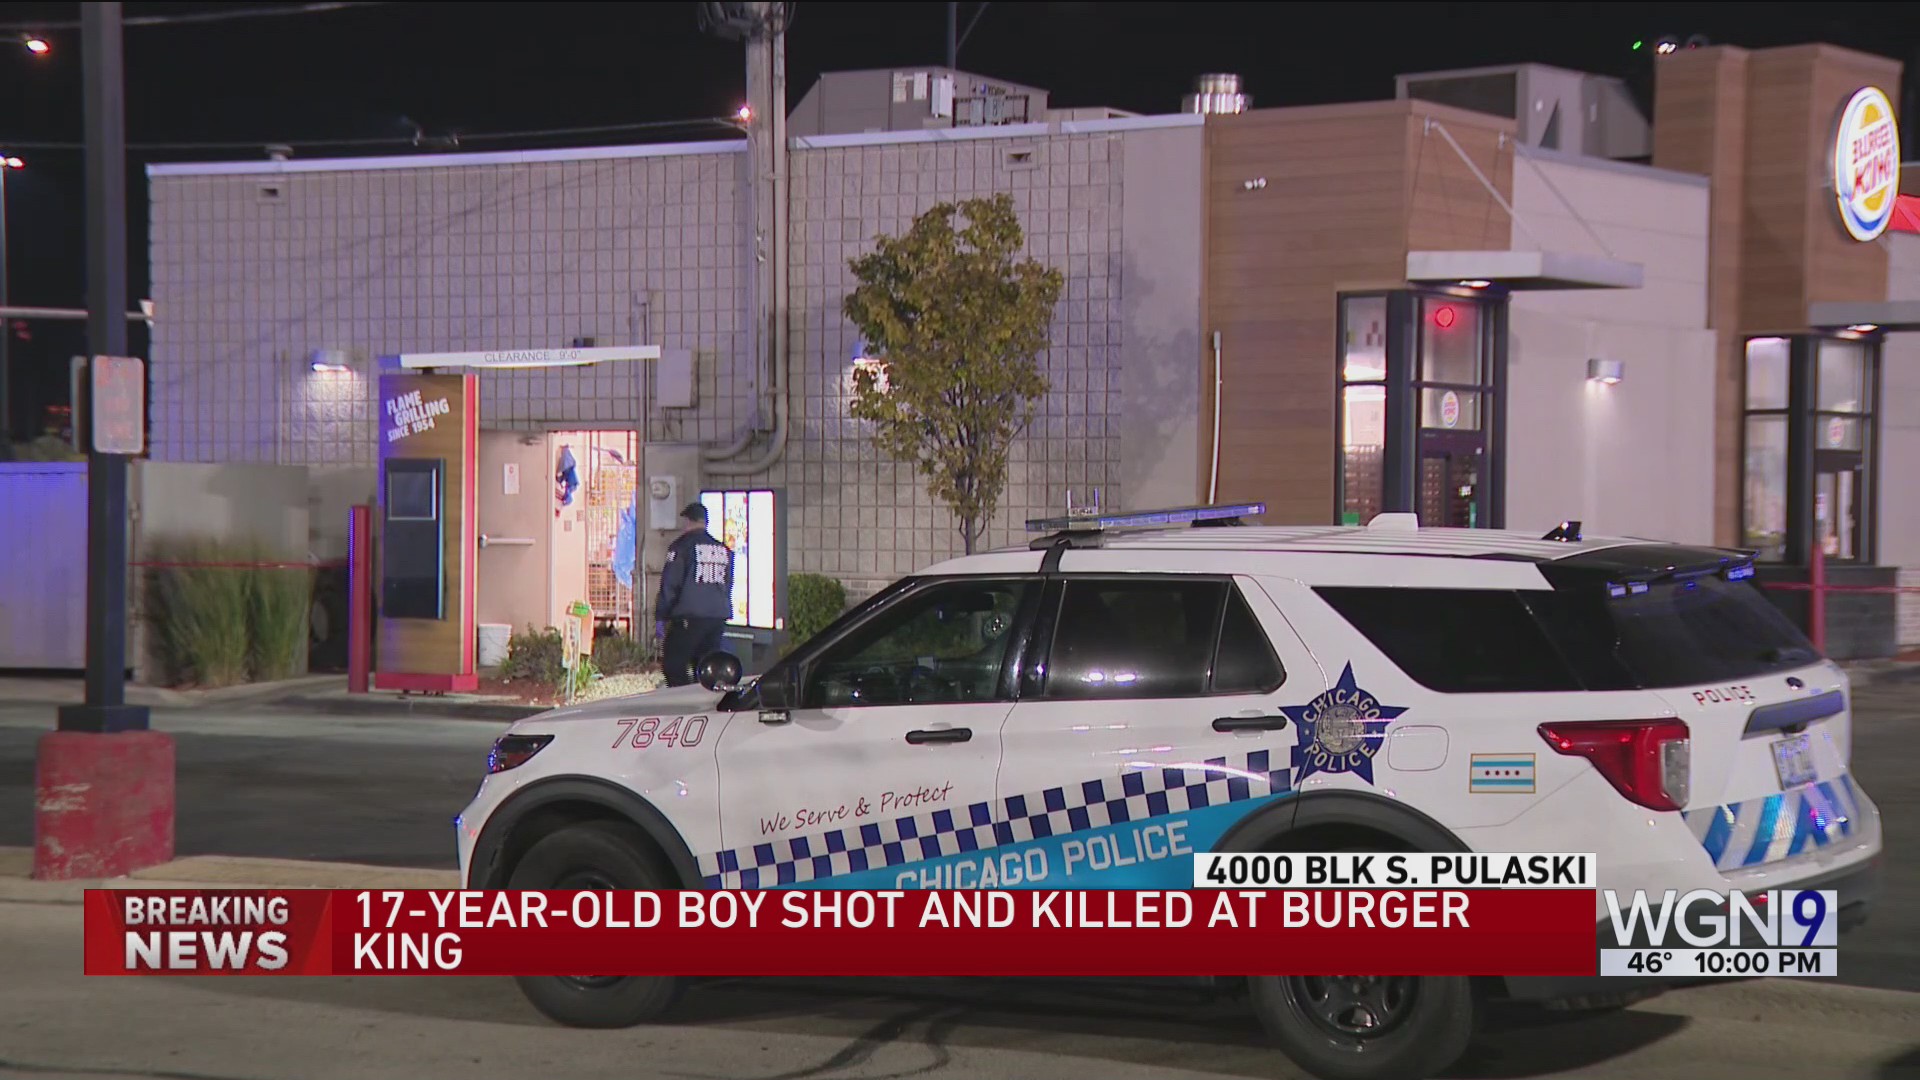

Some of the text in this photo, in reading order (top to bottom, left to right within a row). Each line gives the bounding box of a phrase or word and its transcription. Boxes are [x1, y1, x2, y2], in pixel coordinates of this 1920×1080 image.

[1850, 146, 1891, 203] KING
[484, 351, 550, 363] CLEARANCE
[386, 390, 422, 416] FLAME
[394, 398, 450, 427] GRILLING
[387, 417, 435, 442] SINCE 1954
[694, 563, 727, 584] POLICE
[1302, 689, 1380, 722] CHICAGO
[1692, 685, 1756, 706] POLICE
[612, 715, 709, 749] 7840
[1304, 743, 1375, 771] POLICE
[760, 780, 954, 836] We Serve & Protect
[1062, 819, 1193, 876] POLICE
